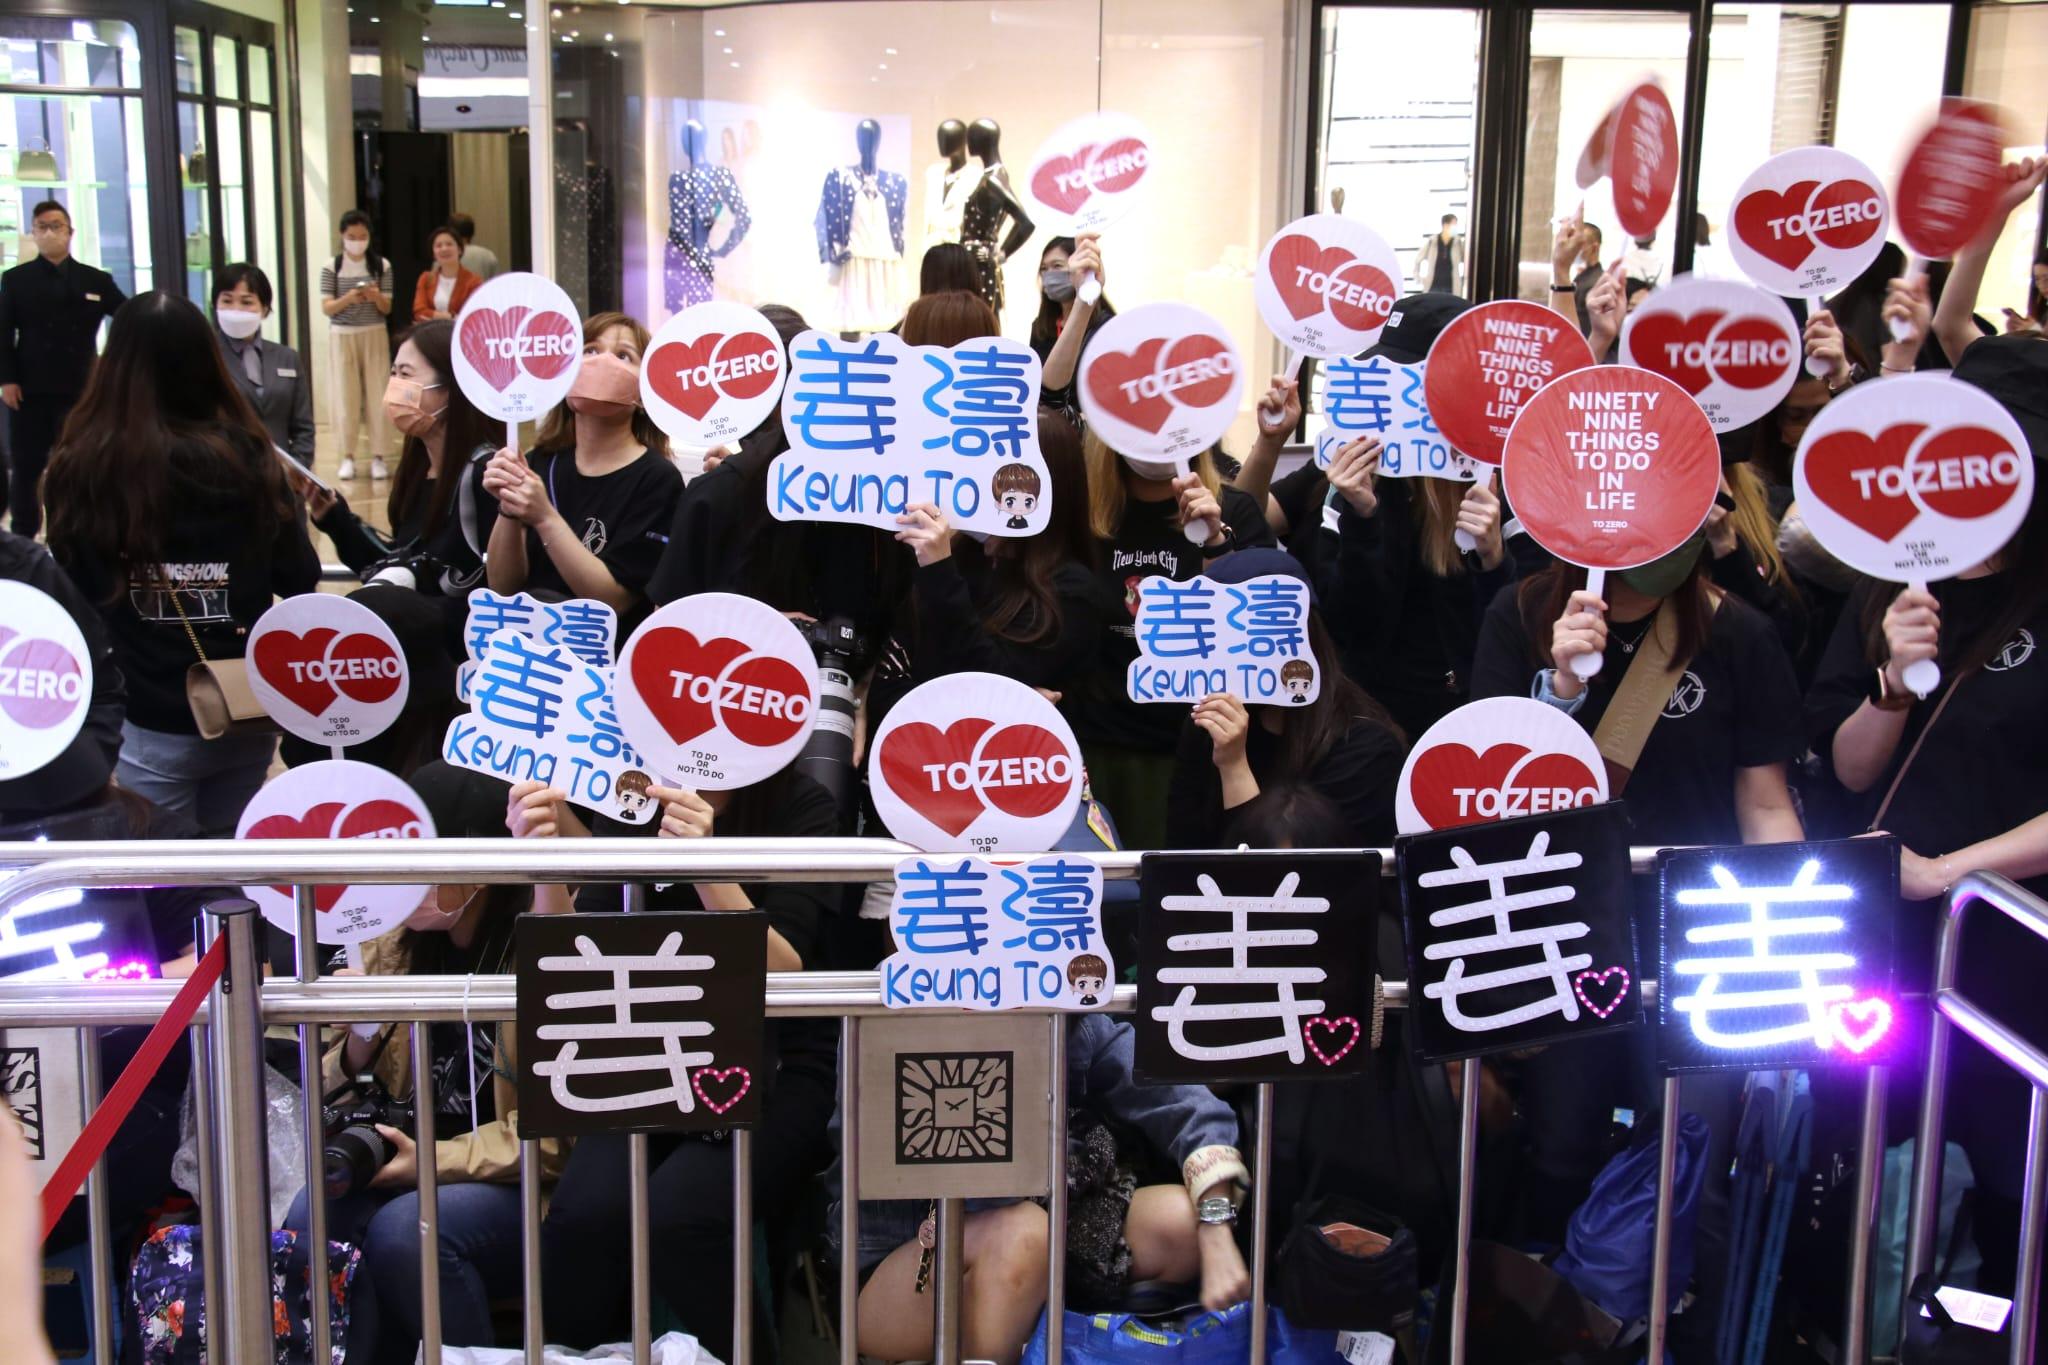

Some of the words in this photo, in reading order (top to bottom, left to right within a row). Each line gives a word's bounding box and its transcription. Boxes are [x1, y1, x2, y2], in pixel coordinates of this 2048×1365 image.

[1483, 318, 1559, 343] NINETY
[1493, 337, 1543, 358] NINE
[1478, 350, 1553, 377] THINGS
[1482, 367, 1509, 386] TO
[1513, 373, 1543, 392] DO
[1498, 387, 1521, 404] IN
[1568, 392, 1660, 410] NINETY
[709, 418, 719, 426] TO
[719, 416, 729, 424] DO
[1584, 412, 1642, 430] NINE
[703, 431, 718, 439] NOT
[1565, 431, 1660, 451] THINGS
[1573, 452, 1607, 470] TO
[1614, 452, 1650, 471] DO
[1599, 472, 1623, 490] IN
[1585, 492, 1636, 510] LIFE
[1592, 520, 1605, 529] TO
[1605, 520, 1629, 529] ZERO
[1905, 542, 1919, 550] TO
[1920, 540, 1936, 549] DO
[1112, 549, 1134, 571] New
[1134, 550, 1158, 567] York
[1158, 550, 1178, 578] City
[1895, 558, 1918, 569] NOT
[1919, 558, 1933, 567] TO
[1934, 557, 1949, 565] DO
[1914, 550, 1928, 559] OR
[691, 750, 703, 759] TO
[705, 752, 718, 762] DO
[696, 760, 709, 769] OR
[677, 764, 697, 775] NOT
[698, 768, 710, 777] TO
[711, 770, 725, 780] DO
[970, 838, 983, 846] TO
[984, 837, 998, 845] DO
[342, 909, 354, 918] TO
[355, 905, 369, 914] DO
[351, 915, 363, 924] OR
[336, 926, 355, 935] NOT
[356, 922, 367, 930] TO
[368, 918, 382, 927] DO
[1418, 830, 1593, 1033] 姜
[1672, 859, 1856, 1050] 姜
[1150, 871, 1330, 1065] 姜
[887, 962, 1000, 1008] Keung
[532, 931, 716, 1113] 姜
